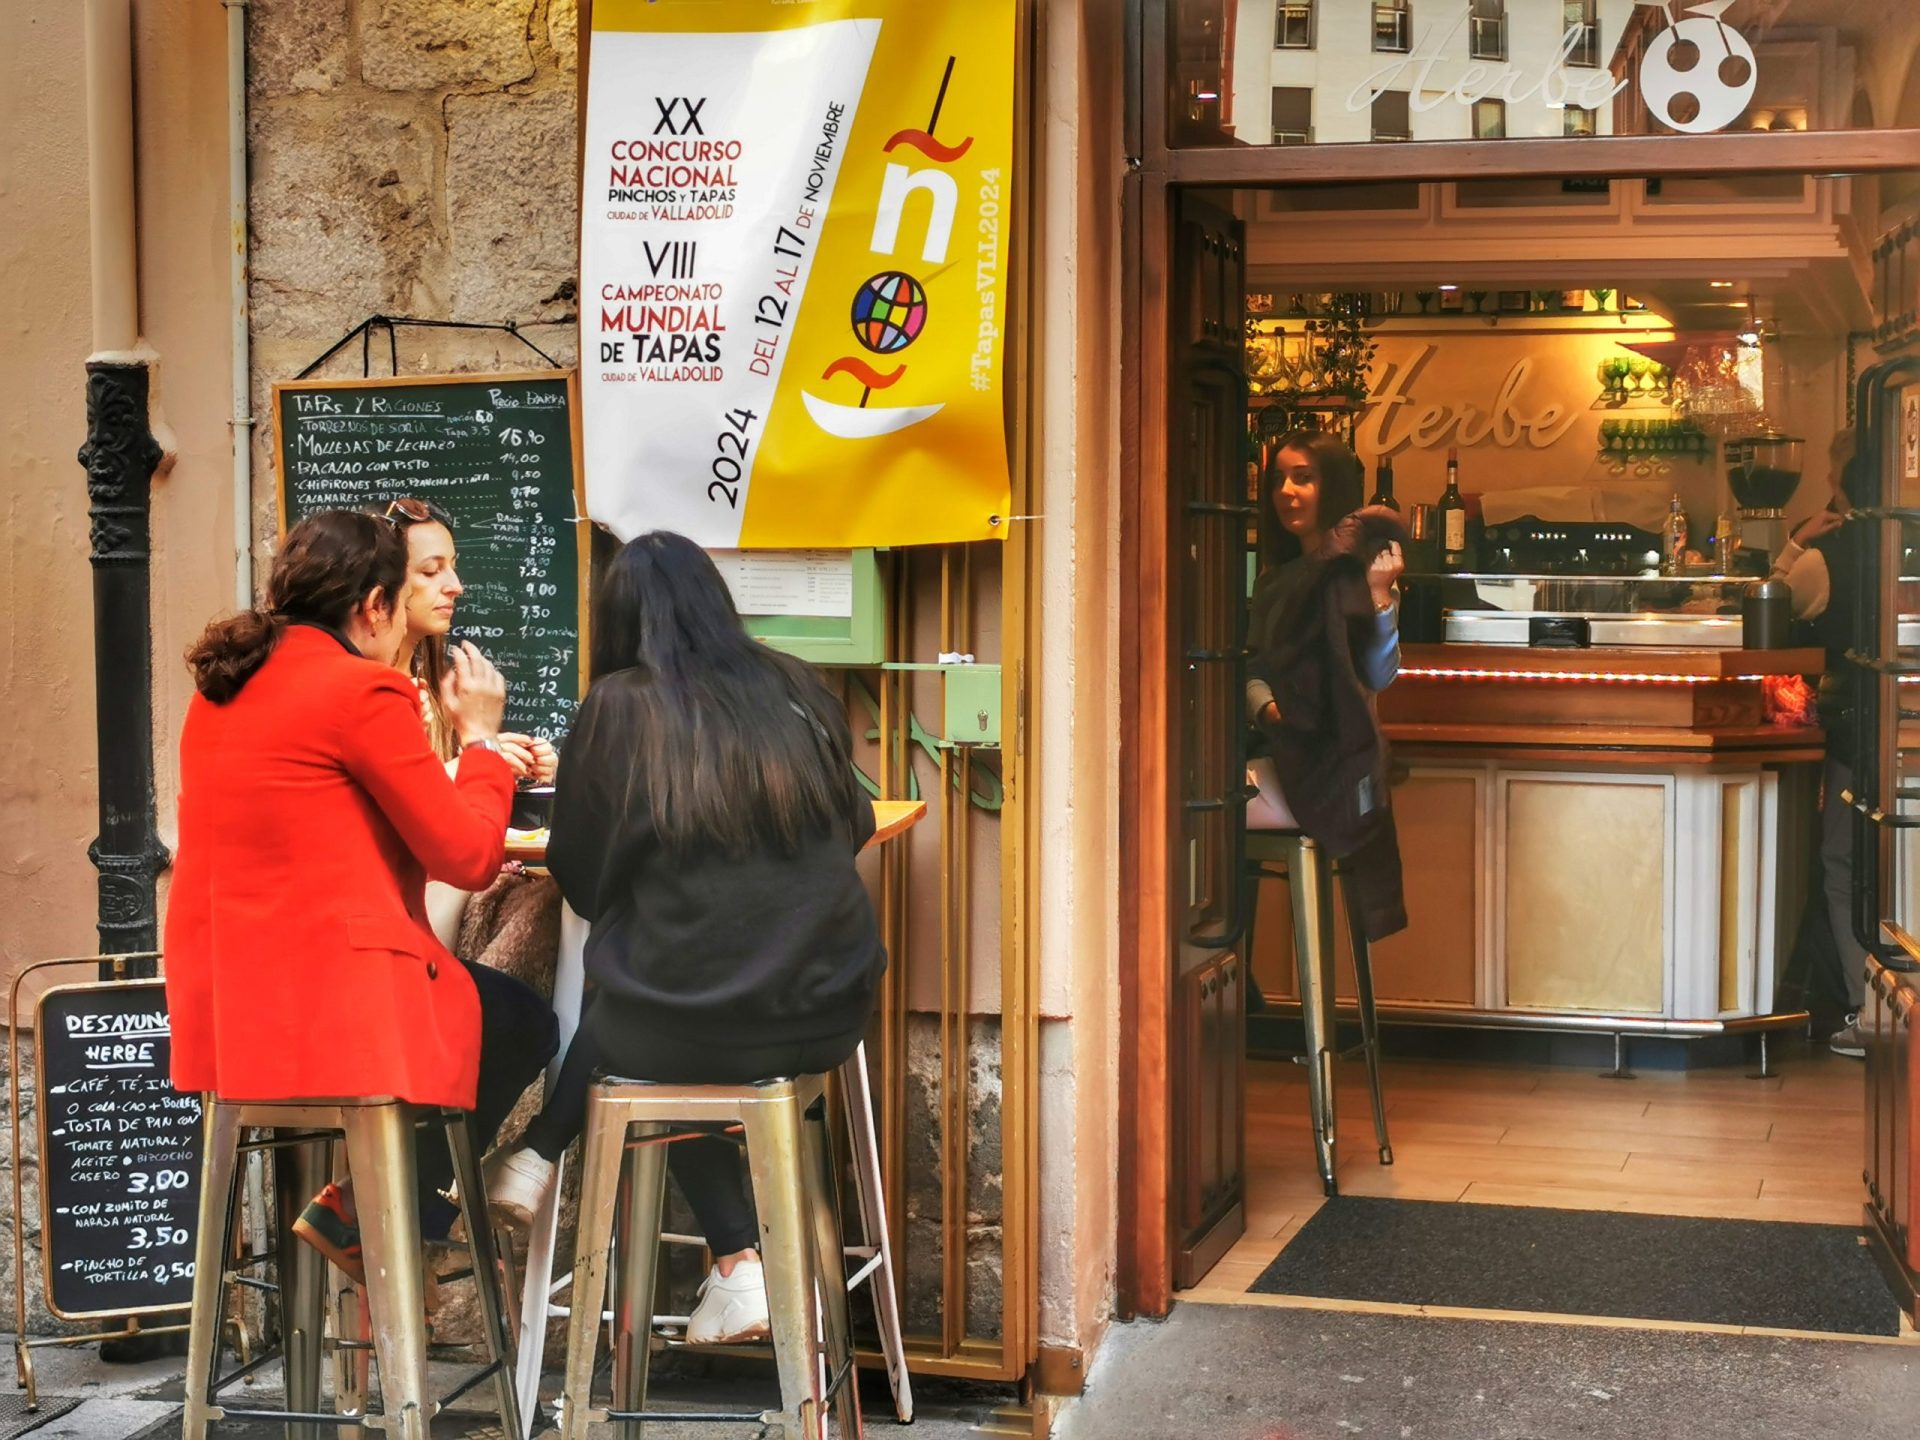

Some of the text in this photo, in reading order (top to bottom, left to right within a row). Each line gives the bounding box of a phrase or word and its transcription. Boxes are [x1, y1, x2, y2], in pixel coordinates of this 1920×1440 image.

[1345, 5, 1629, 112] Herbe
[653, 97, 707, 135] XX
[611, 140, 742, 161] CONCURSO
[610, 165, 738, 187] NACIONAL
[608, 189, 676, 202] PINCHOS
[690, 189, 736, 202] TAPAS
[607, 204, 734, 221] CIUDAD DE VALLADOLID
[749, 101, 845, 376] DEL 12 AL 17 DE NOVIEMBRE
[643, 241, 697, 279] VIII
[970, 167, 1001, 391] #TapasVLL2024
[601, 283, 722, 301] CAMPEONATO
[601, 304, 726, 332] MUNDIAL
[600, 333, 721, 363] DE TAPAS
[601, 366, 723, 382] CIUDAD DE VALLADOLID
[355, 396, 365, 414] Y
[1355, 344, 1579, 455] Herbe
[370, 421, 385, 436] DE
[375, 439, 393, 453] DE
[707, 408, 758, 509] 2024
[297, 461, 362, 476] BACALAO
[365, 461, 389, 472] CON
[297, 492, 360, 504] CALAMARES
[534, 512, 543, 523] 5
[537, 665, 561, 677] 10
[538, 681, 558, 695] 12
[85, 1043, 155, 1062] HERBE
[64, 1118, 112, 1132] TOSTA
[118, 1118, 141, 1132] DE
[145, 1116, 172, 1128] PAN
[64, 1141, 113, 1151] TOMATE
[120, 1136, 178, 1149] NATURAL
[70, 1170, 189, 1193] CASERO 3,00
[72, 1203, 101, 1215] CON
[152, 1199, 169, 1209] DE
[123, 1213, 174, 1225] NATURAL
[126, 1226, 189, 1249] 3,50
[128, 1257, 147, 1267] DE
